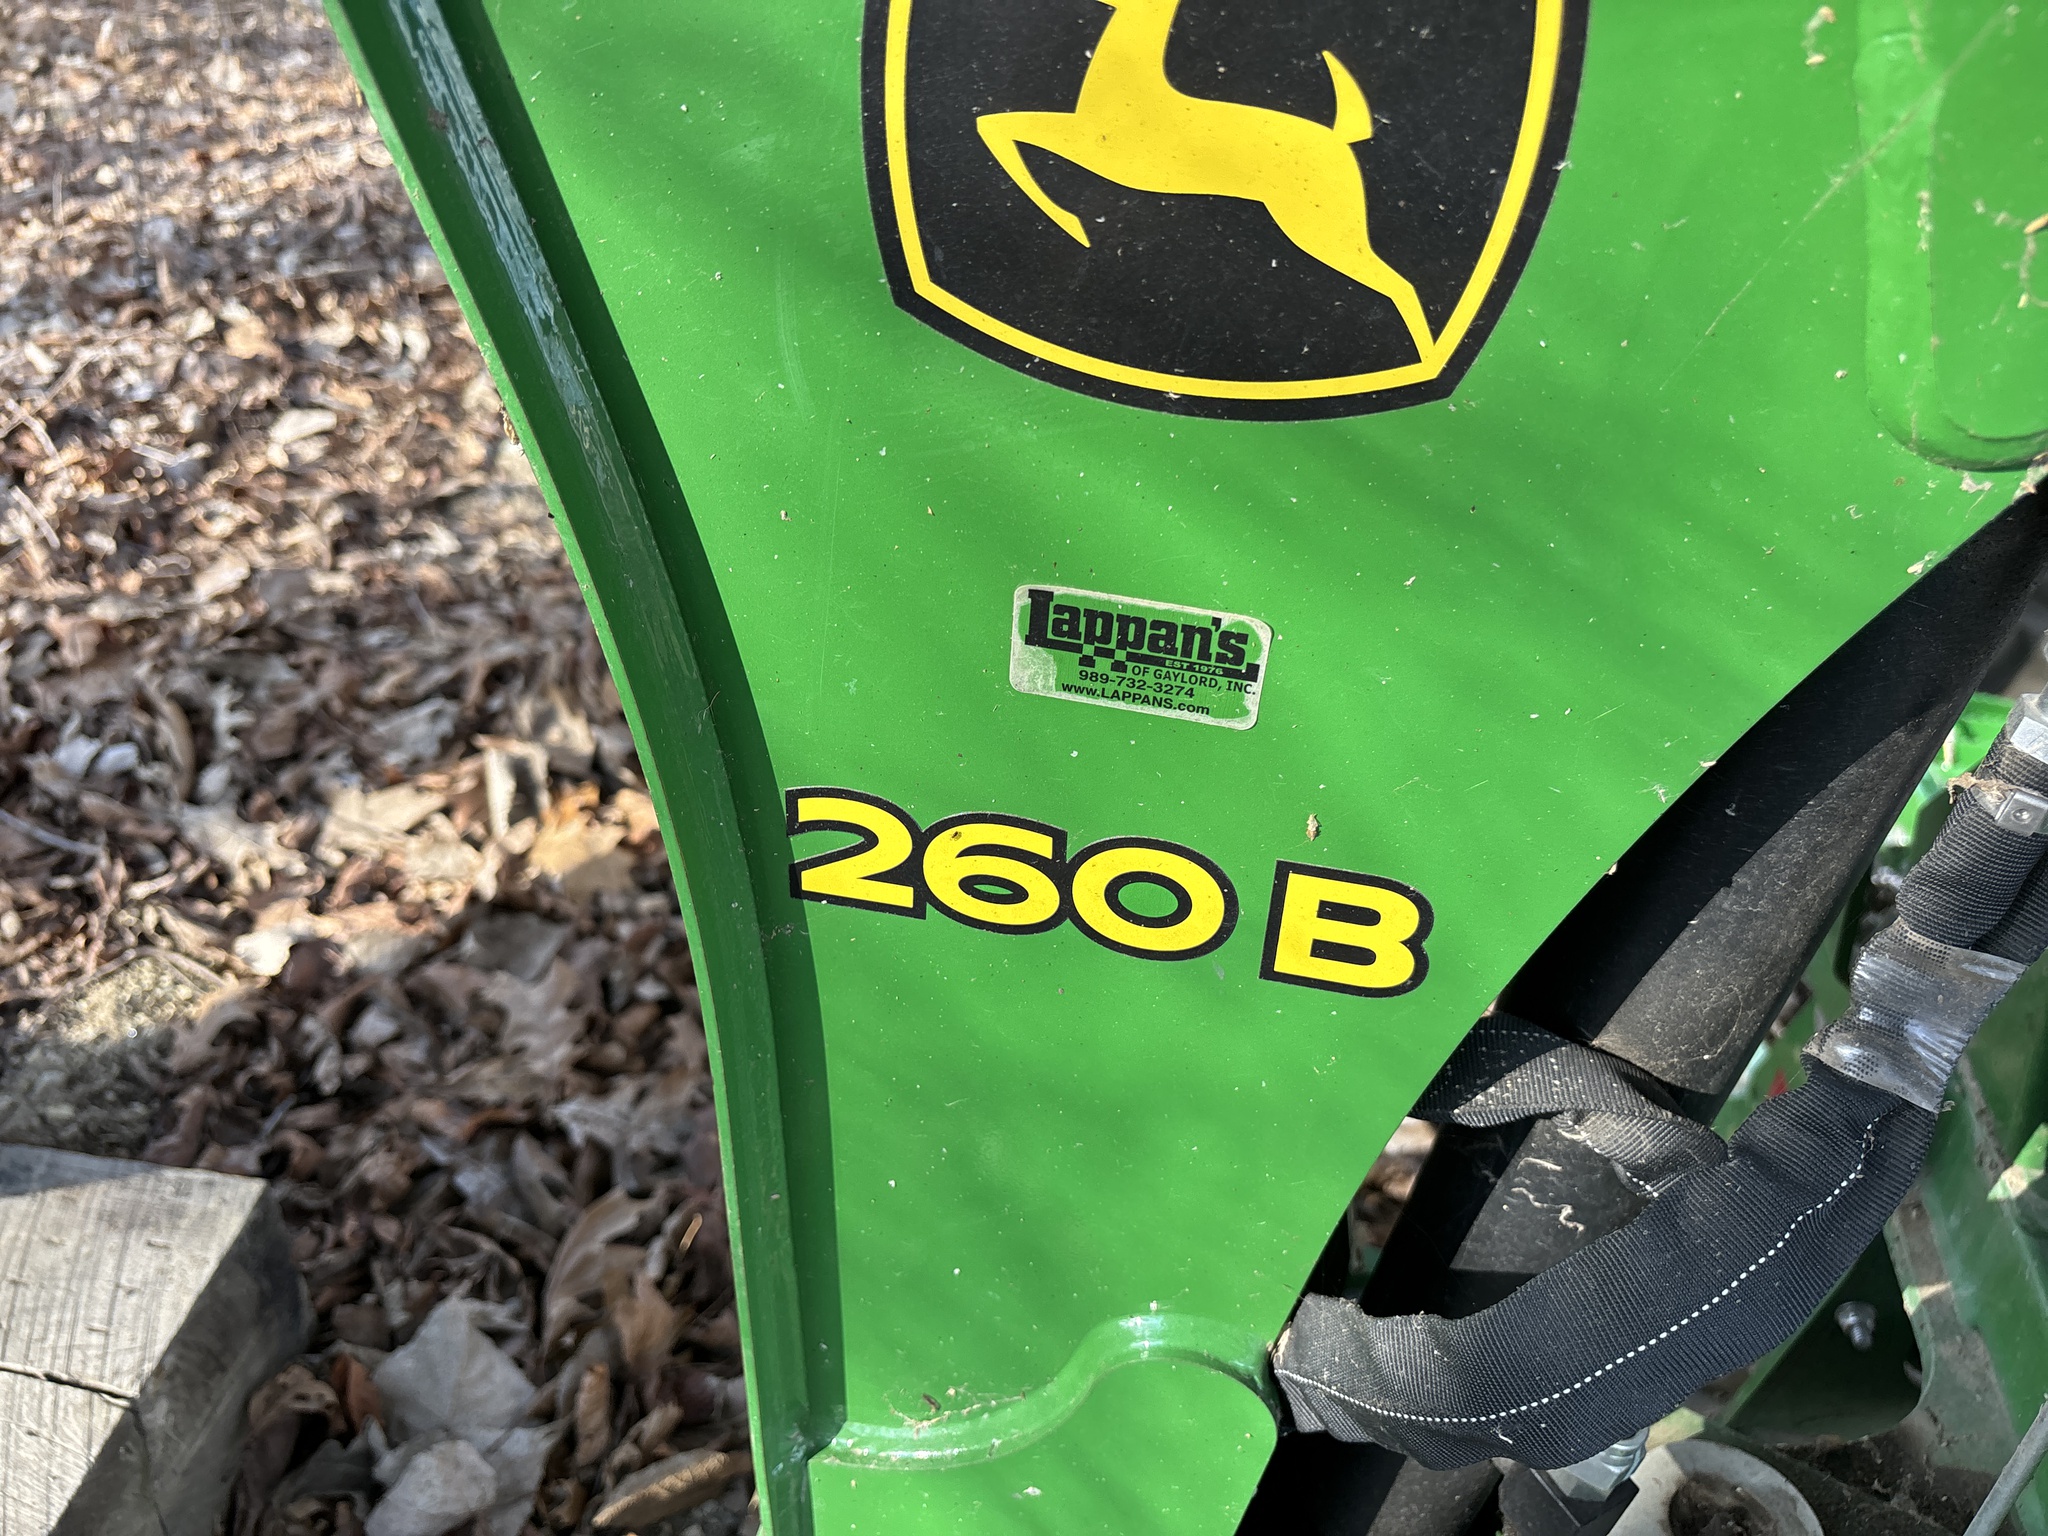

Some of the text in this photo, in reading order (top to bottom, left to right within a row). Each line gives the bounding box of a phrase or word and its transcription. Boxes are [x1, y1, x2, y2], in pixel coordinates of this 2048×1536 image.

[1025, 589, 1252, 676] Lappan's
[1131, 665, 1256, 695] OF GAYLORD, INC.
[1165, 660, 1223, 675] EST 1976
[1061, 682, 1210, 715] www.LAPPANS.com
[1078, 669, 1195, 698] 989-732-3274
[786, 787, 1433, 996] 260 B
